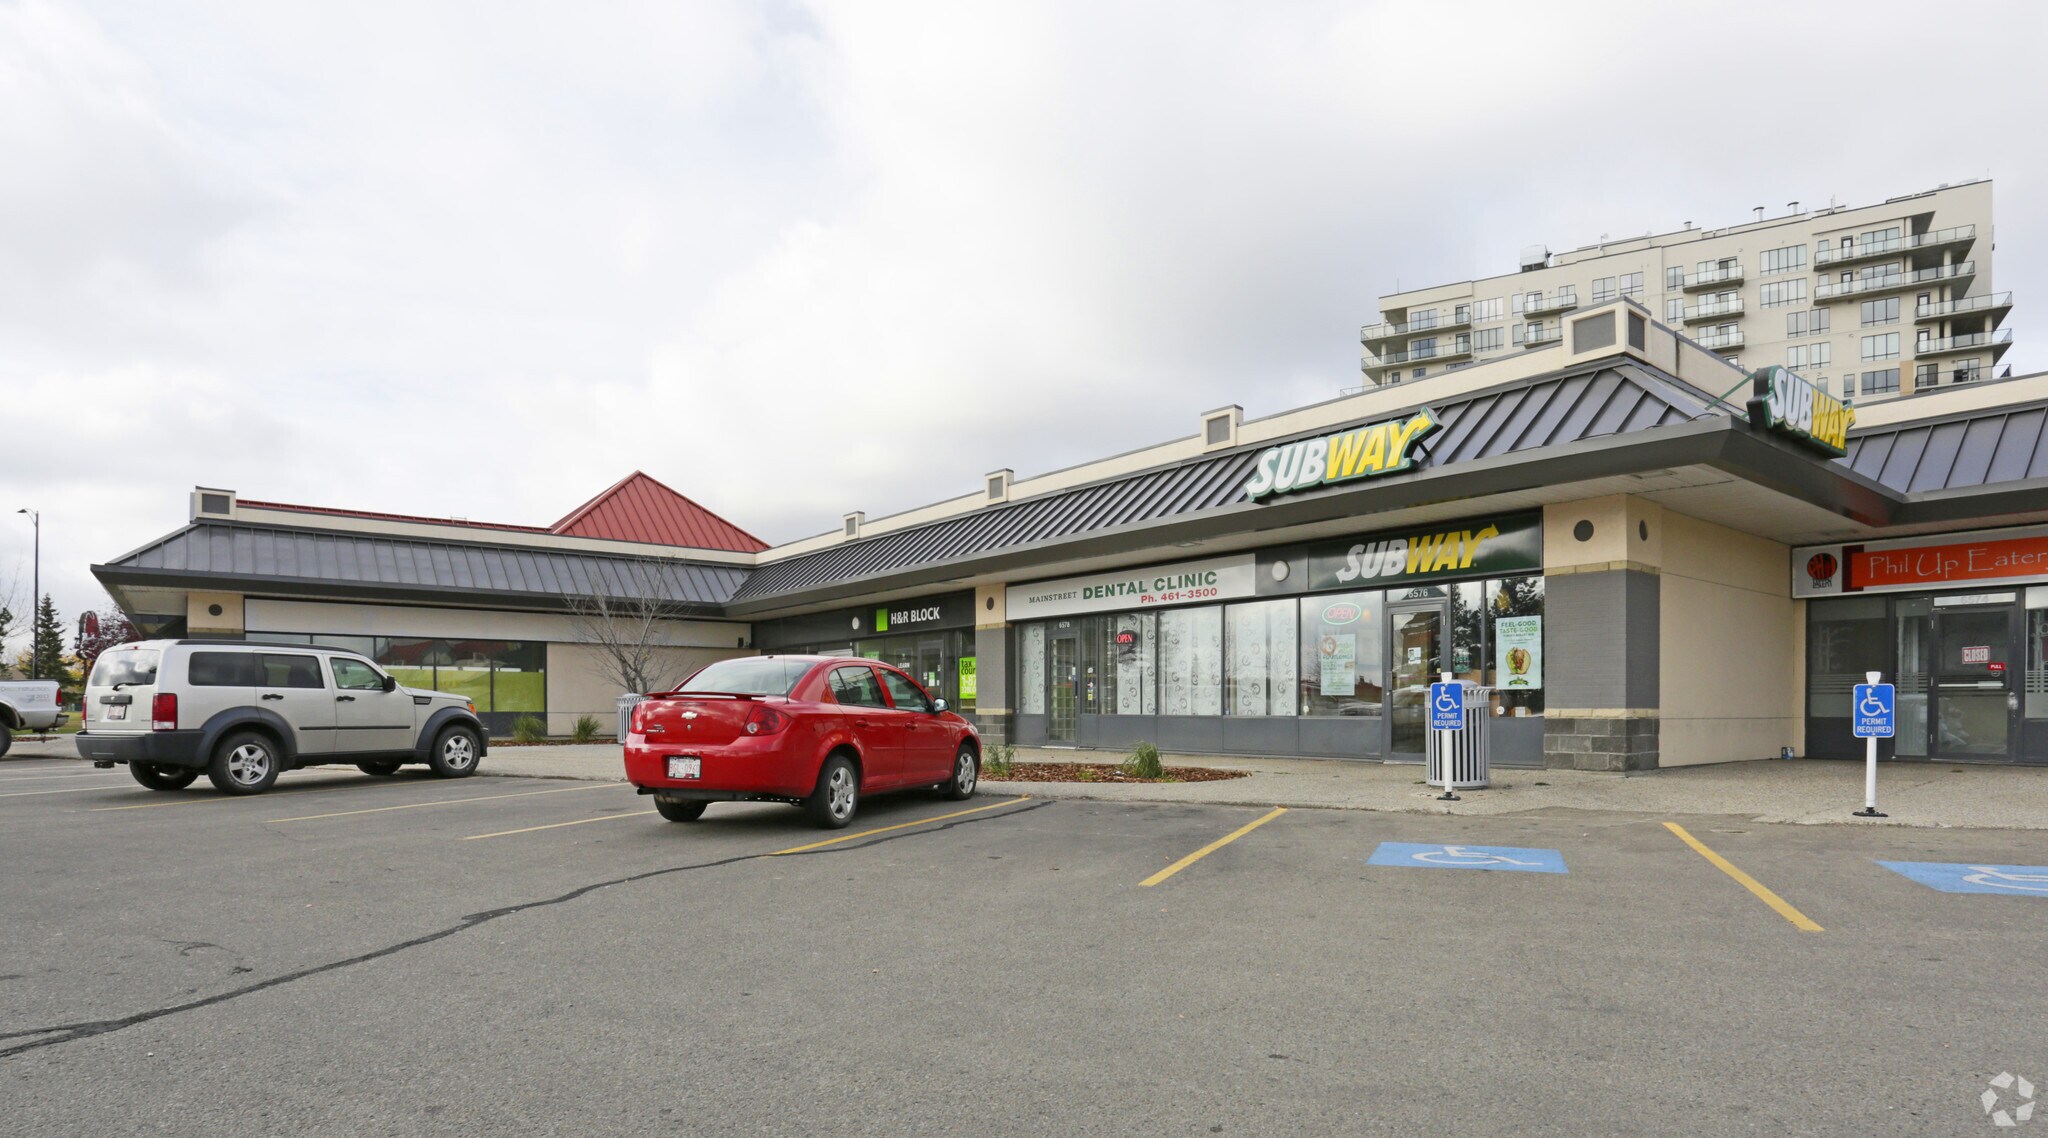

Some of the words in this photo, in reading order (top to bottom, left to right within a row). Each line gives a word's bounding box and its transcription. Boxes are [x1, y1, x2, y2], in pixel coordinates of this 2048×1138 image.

[1768, 367, 1856, 450] SUBWAY
[1246, 413, 1431, 496] SUBWAY
[1335, 524, 1499, 583] SUBWAY
[1870, 554, 1909, 579] Phil
[1916, 552, 1959, 579] Up
[1968, 548, 2048, 572] Eater
[1028, 591, 1078, 604] MAINSTREET
[1083, 580, 1148, 600] DENTAL
[1154, 571, 1218, 592] CLINIC
[1408, 588, 1429, 598] 6576
[1141, 594, 1158, 604] Ph.
[1161, 587, 1218, 602] 461-3500
[890, 611, 909, 625] H&R
[910, 606, 941, 622] BLOCK
[1327, 607, 1356, 619] OPEN
[1116, 634, 1133, 643] OPEN
[1963, 648, 1988, 662] CLOSED
[961, 659, 973, 668] tax
[1433, 719, 1462, 727] REQUIRED
[1861, 717, 1887, 725] PERMIT
[1856, 725, 1892, 734] REQUIRED
